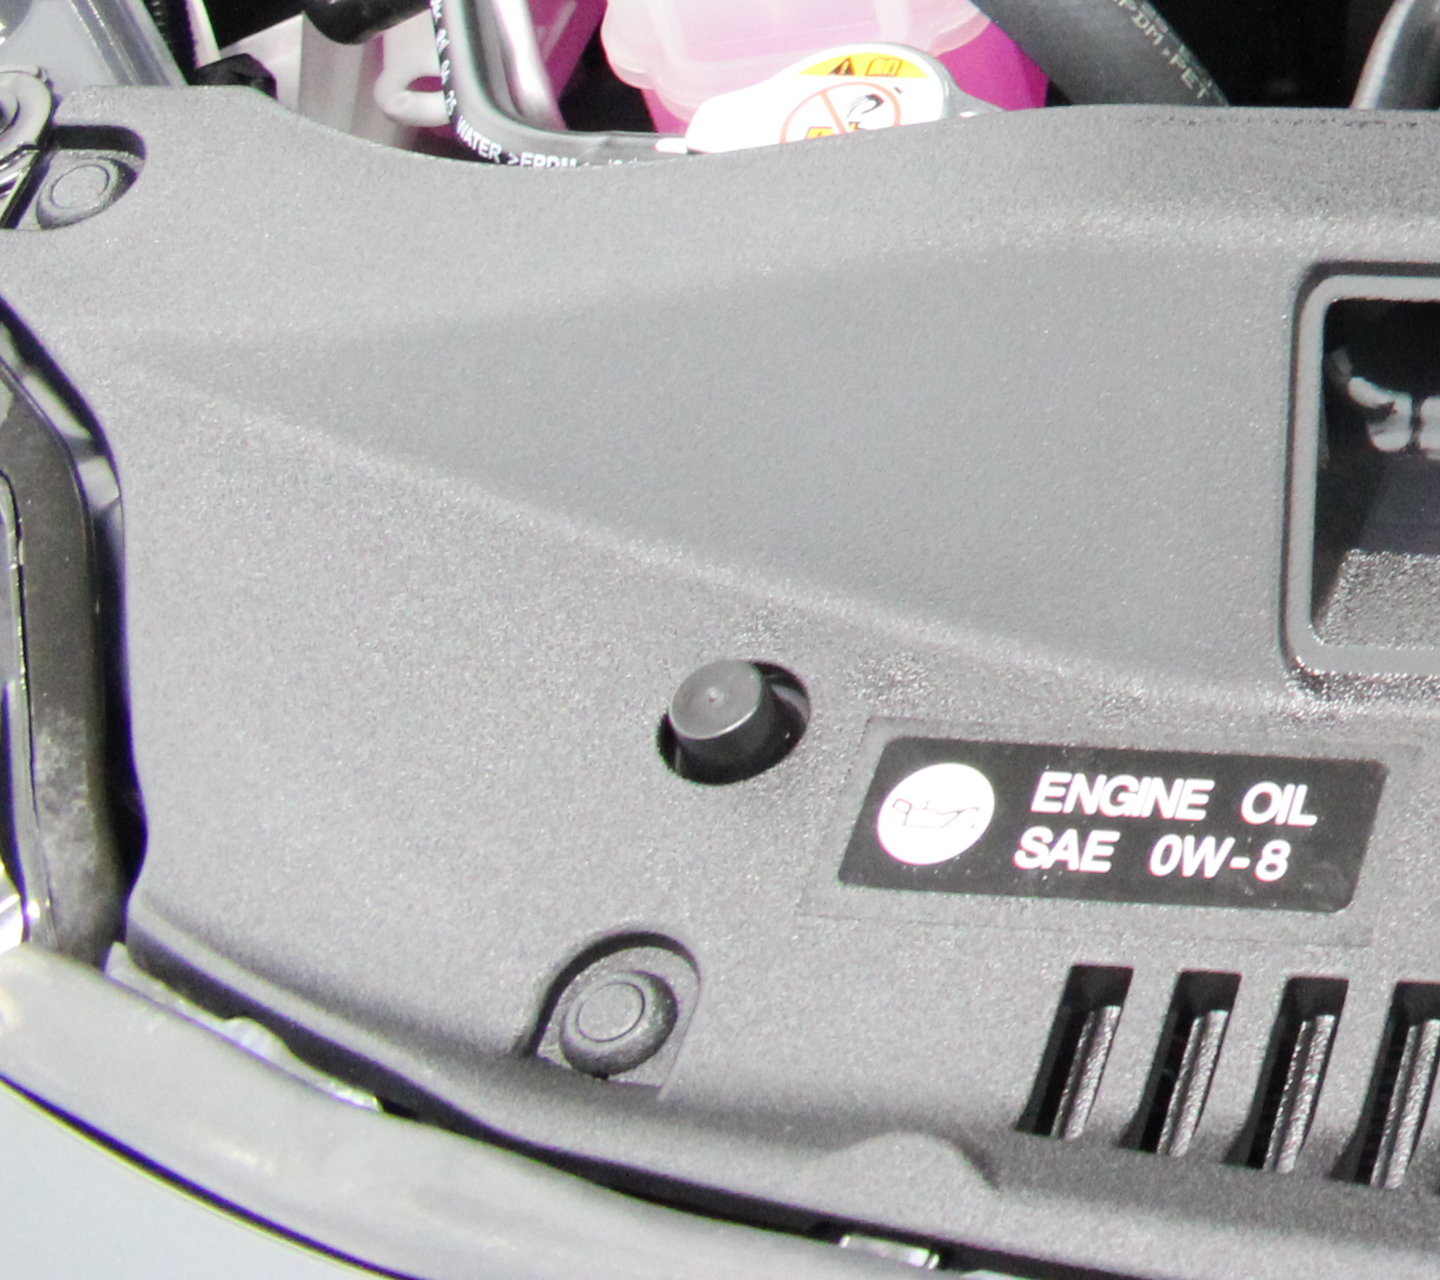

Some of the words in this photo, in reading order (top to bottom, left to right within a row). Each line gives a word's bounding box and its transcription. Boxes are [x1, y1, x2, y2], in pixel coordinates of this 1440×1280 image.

[456, 115, 503, 164] WATER
[1030, 771, 1215, 821] ENGINE
[1241, 781, 1318, 827] OIL
[1013, 826, 1120, 872] SAE
[1148, 833, 1291, 882] 0W-8
